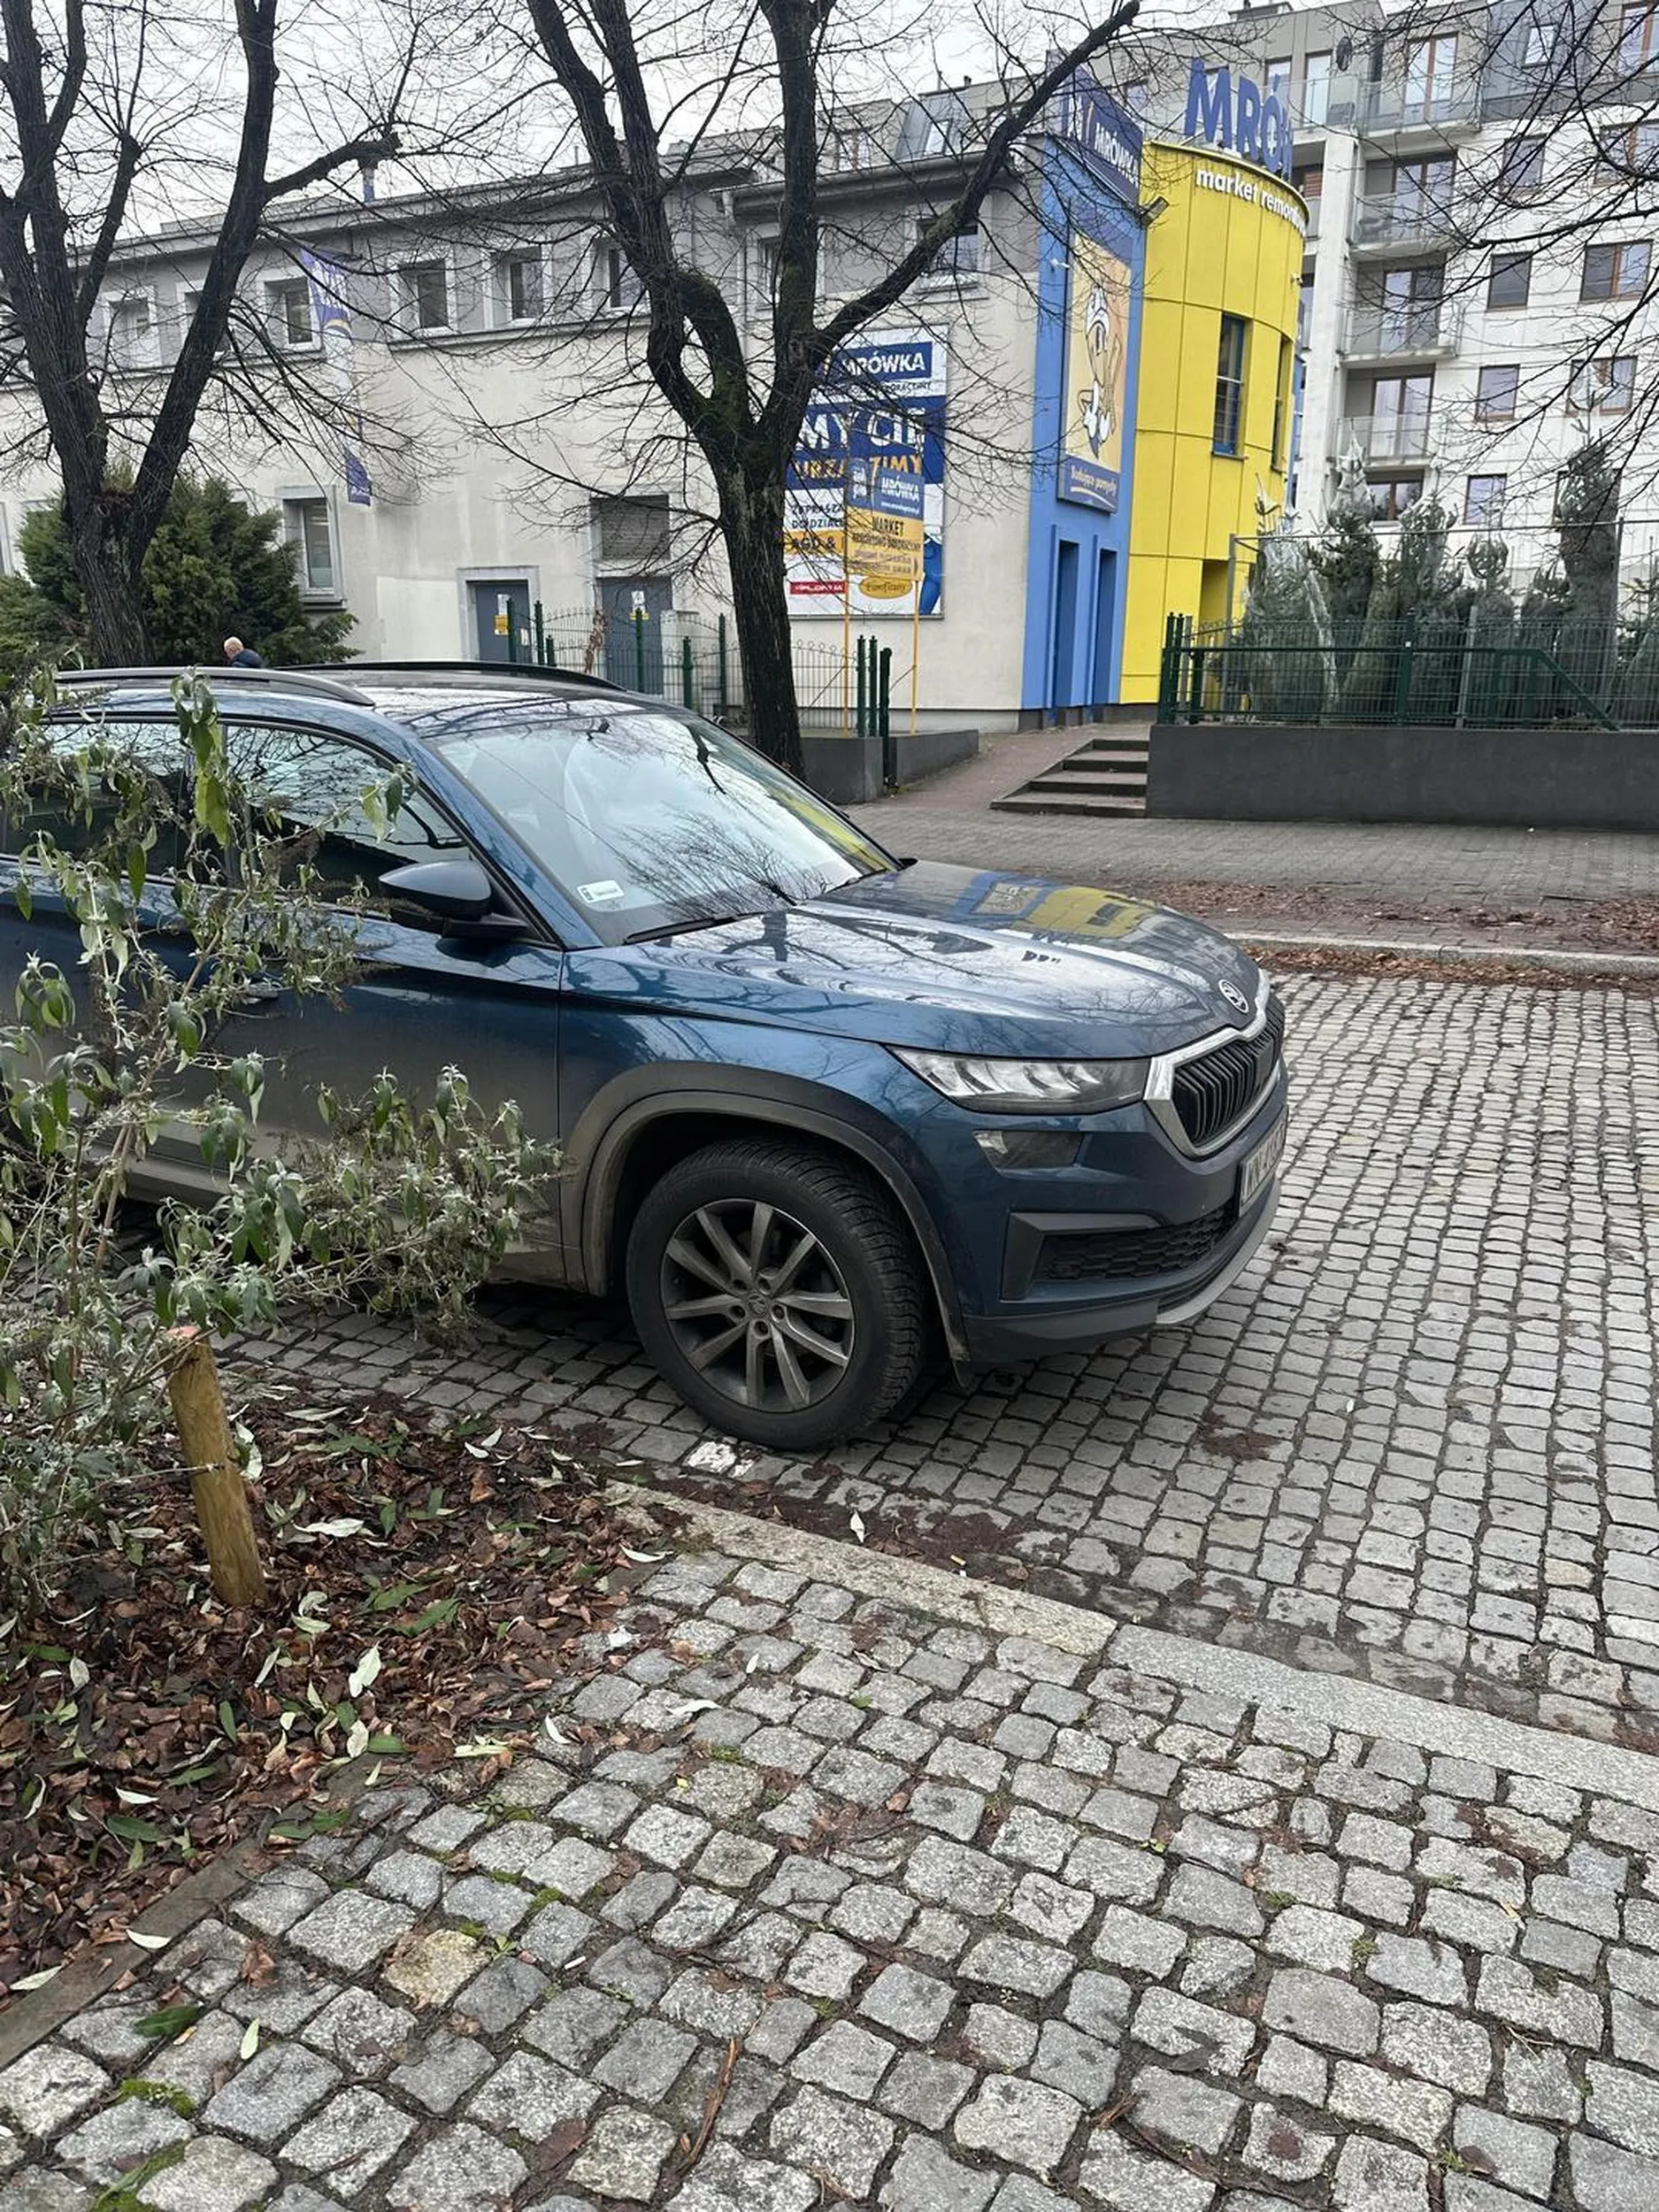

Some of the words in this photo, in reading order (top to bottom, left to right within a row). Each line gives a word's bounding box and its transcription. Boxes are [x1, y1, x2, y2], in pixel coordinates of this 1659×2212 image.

[1196, 170, 1258, 203] market
[842, 351, 926, 376] MRÓWKA
[872, 516, 904, 537] MARKET
